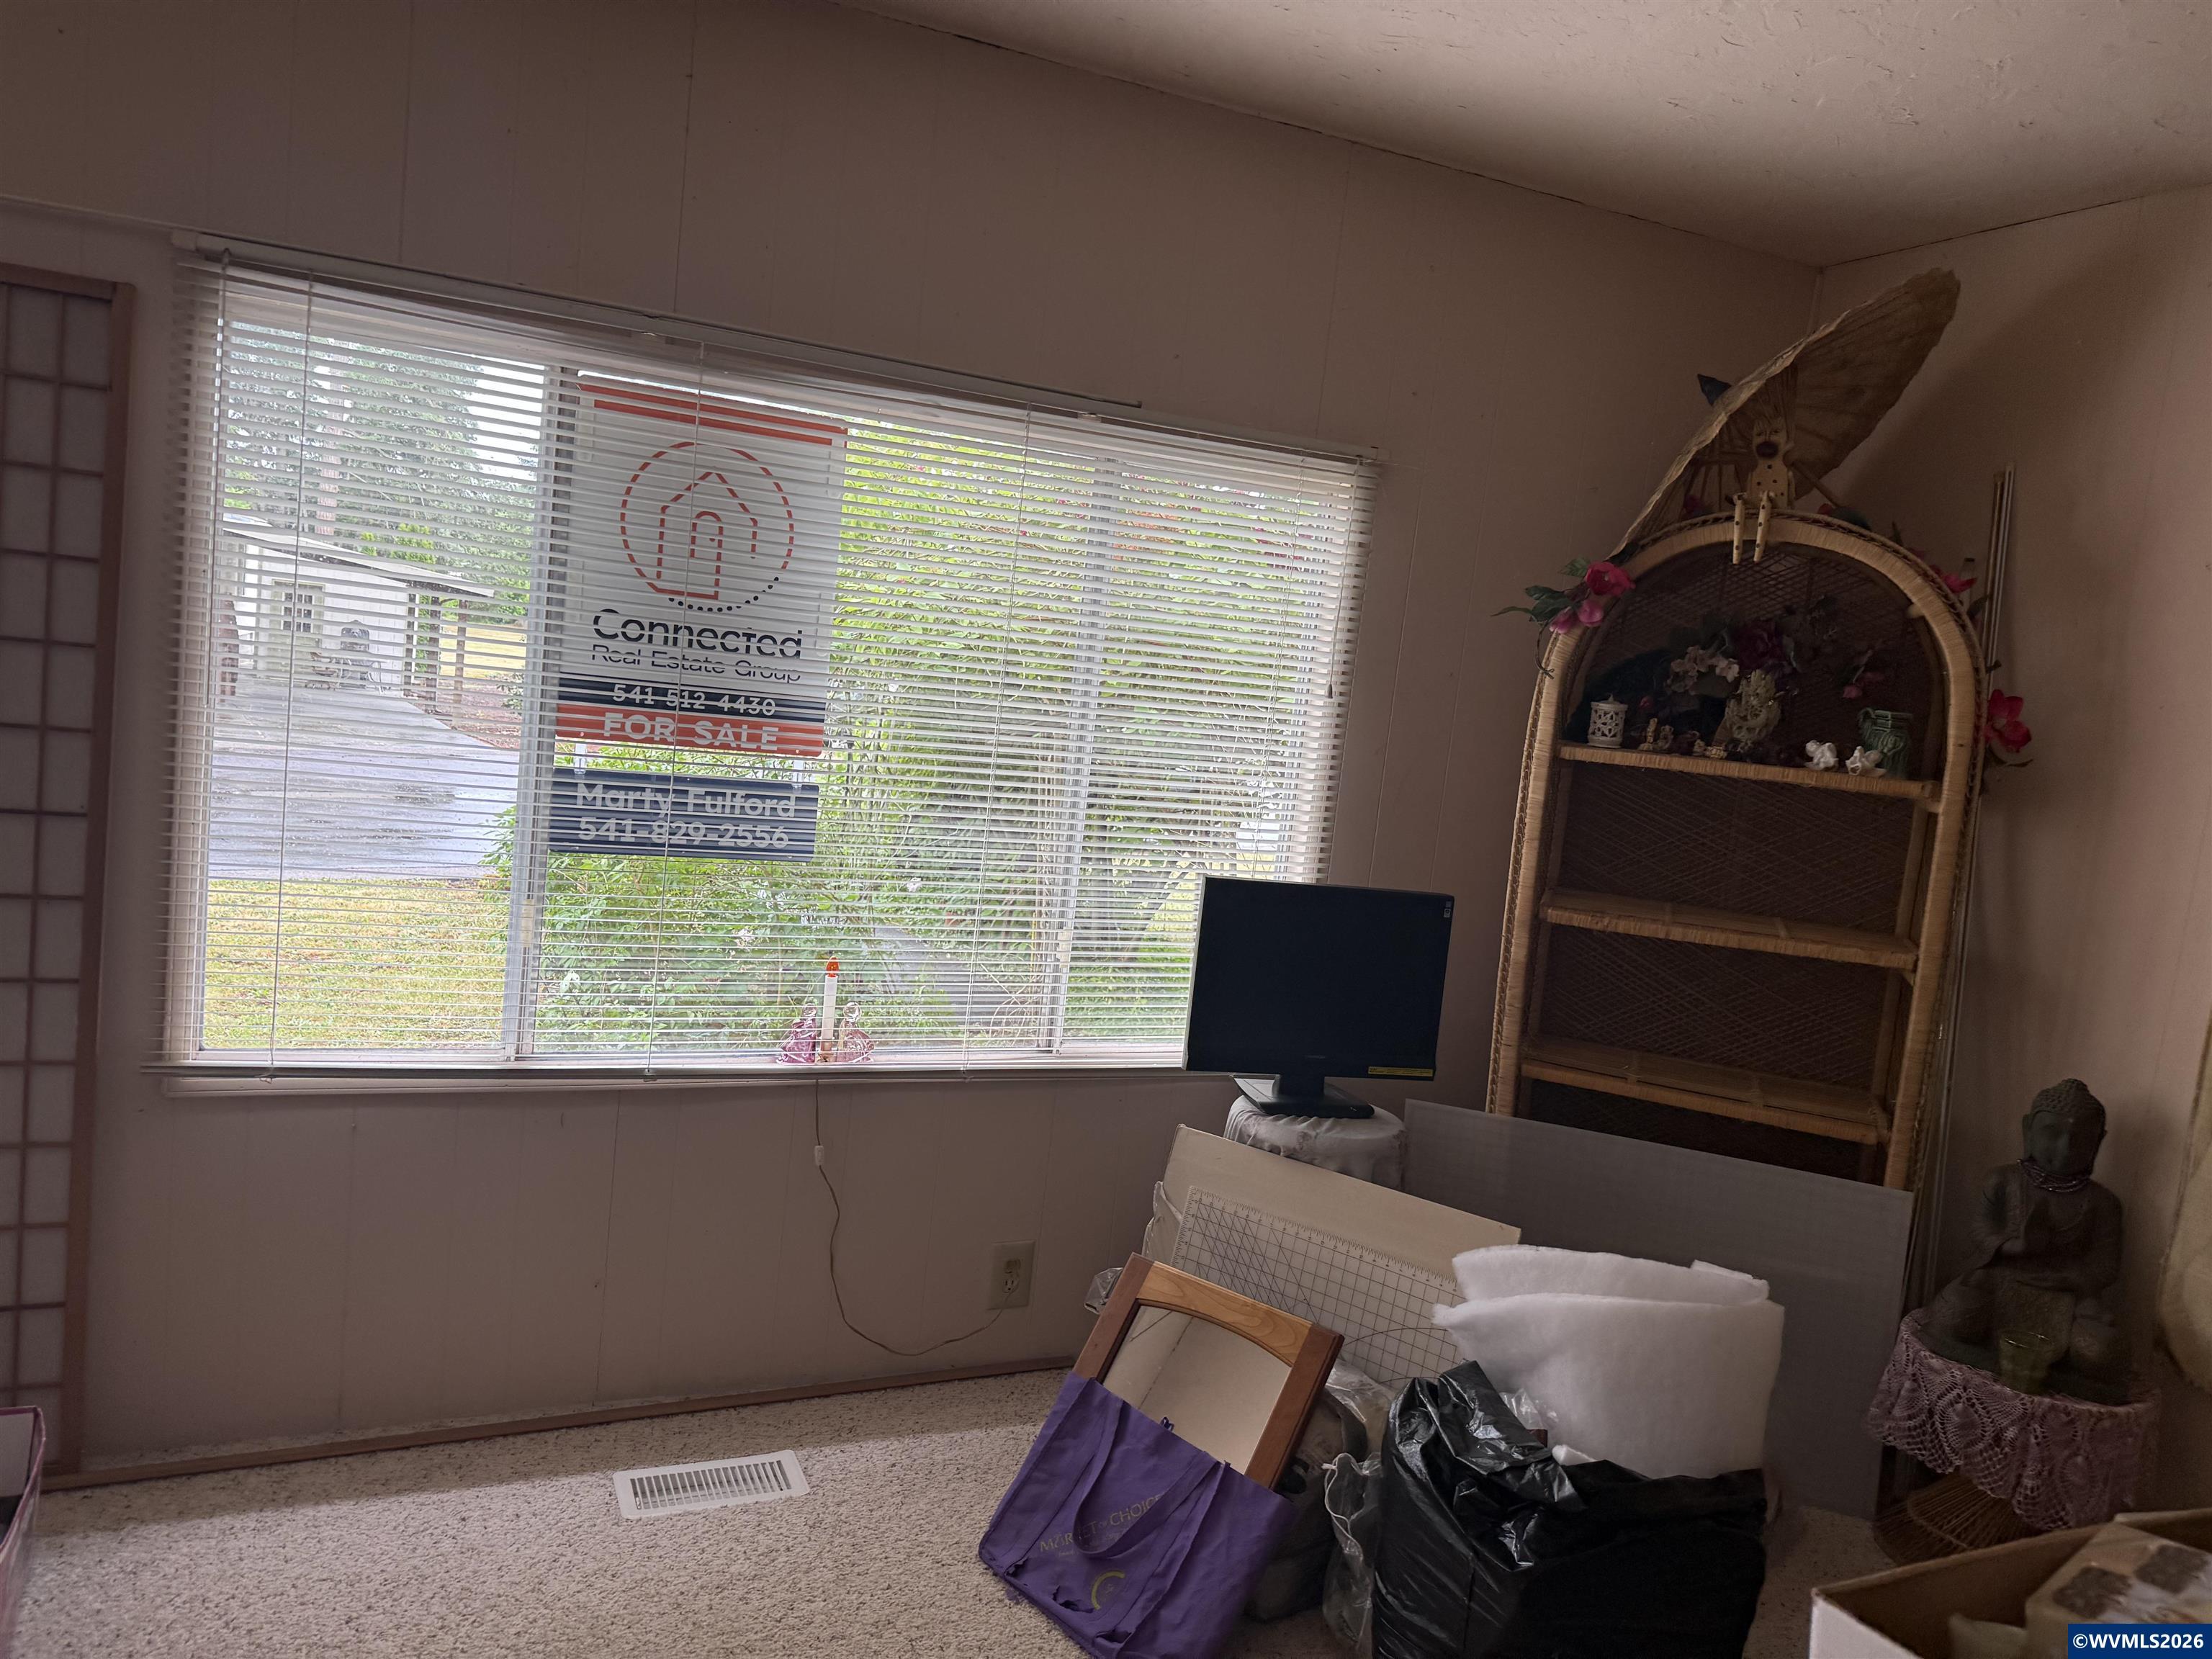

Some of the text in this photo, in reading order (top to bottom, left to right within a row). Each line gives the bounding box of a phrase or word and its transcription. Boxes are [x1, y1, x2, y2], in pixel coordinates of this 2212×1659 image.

[593, 608, 803, 660] Connected
[592, 644, 801, 684] Real Estate Group
[603, 712, 779, 751] FOR SALE
[576, 783, 796, 818] Marty Fulford
[577, 816, 790, 848] 541-829-2556
